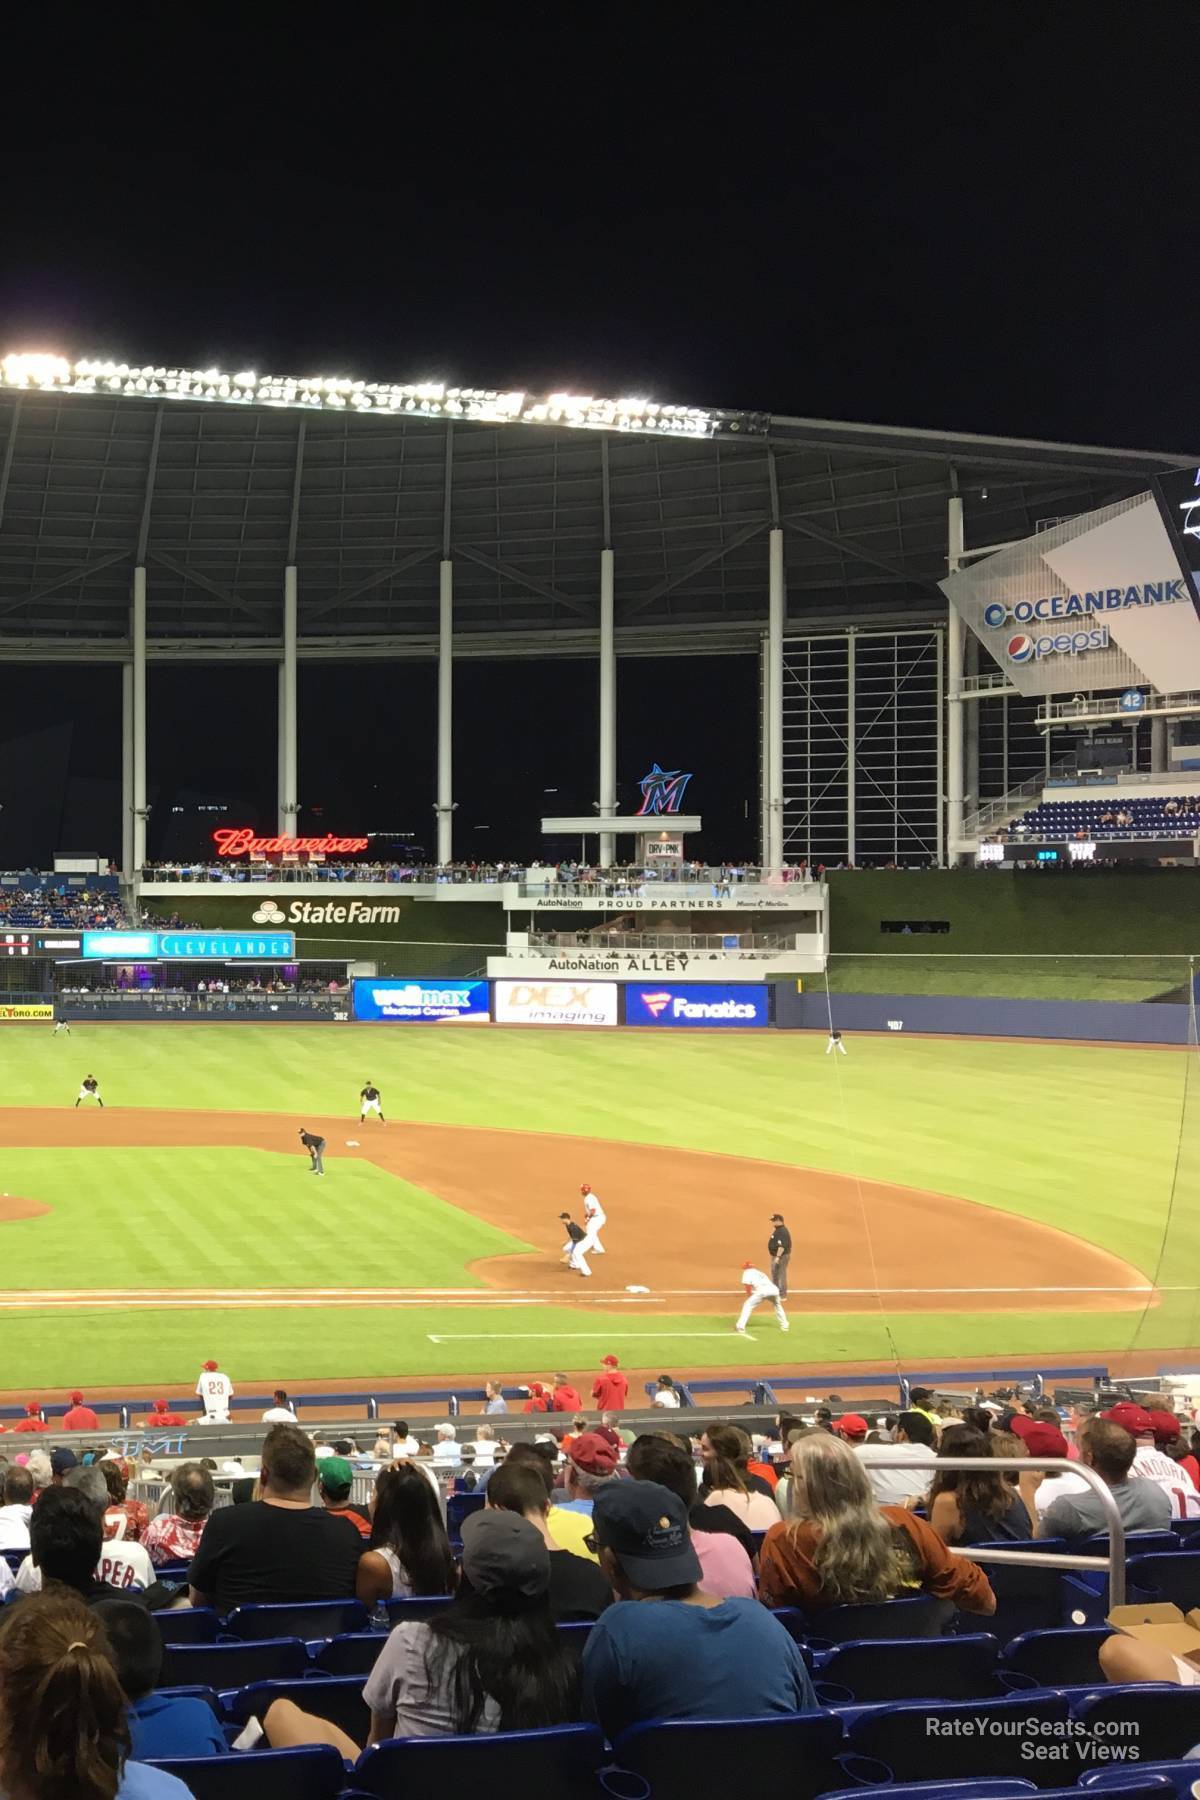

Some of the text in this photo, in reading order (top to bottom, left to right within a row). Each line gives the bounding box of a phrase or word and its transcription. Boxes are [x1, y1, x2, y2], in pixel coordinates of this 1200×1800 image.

[1034, 624, 1109, 659] pepsi
[1123, 693, 1141, 708] 42
[213, 828, 369, 856] Budweiser
[536, 898, 584, 909] AutoNation
[598, 899, 723, 910] PROUD PARTNERS
[288, 901, 401, 925] State Farm
[161, 936, 290, 956] CLEVELANDER
[548, 959, 690, 974] AutoNation ALLEY
[508, 986, 593, 1007] DEX
[673, 998, 757, 1019] Fanatics
[529, 1011, 607, 1024] imaging
[208, 1381, 225, 1395] 23
